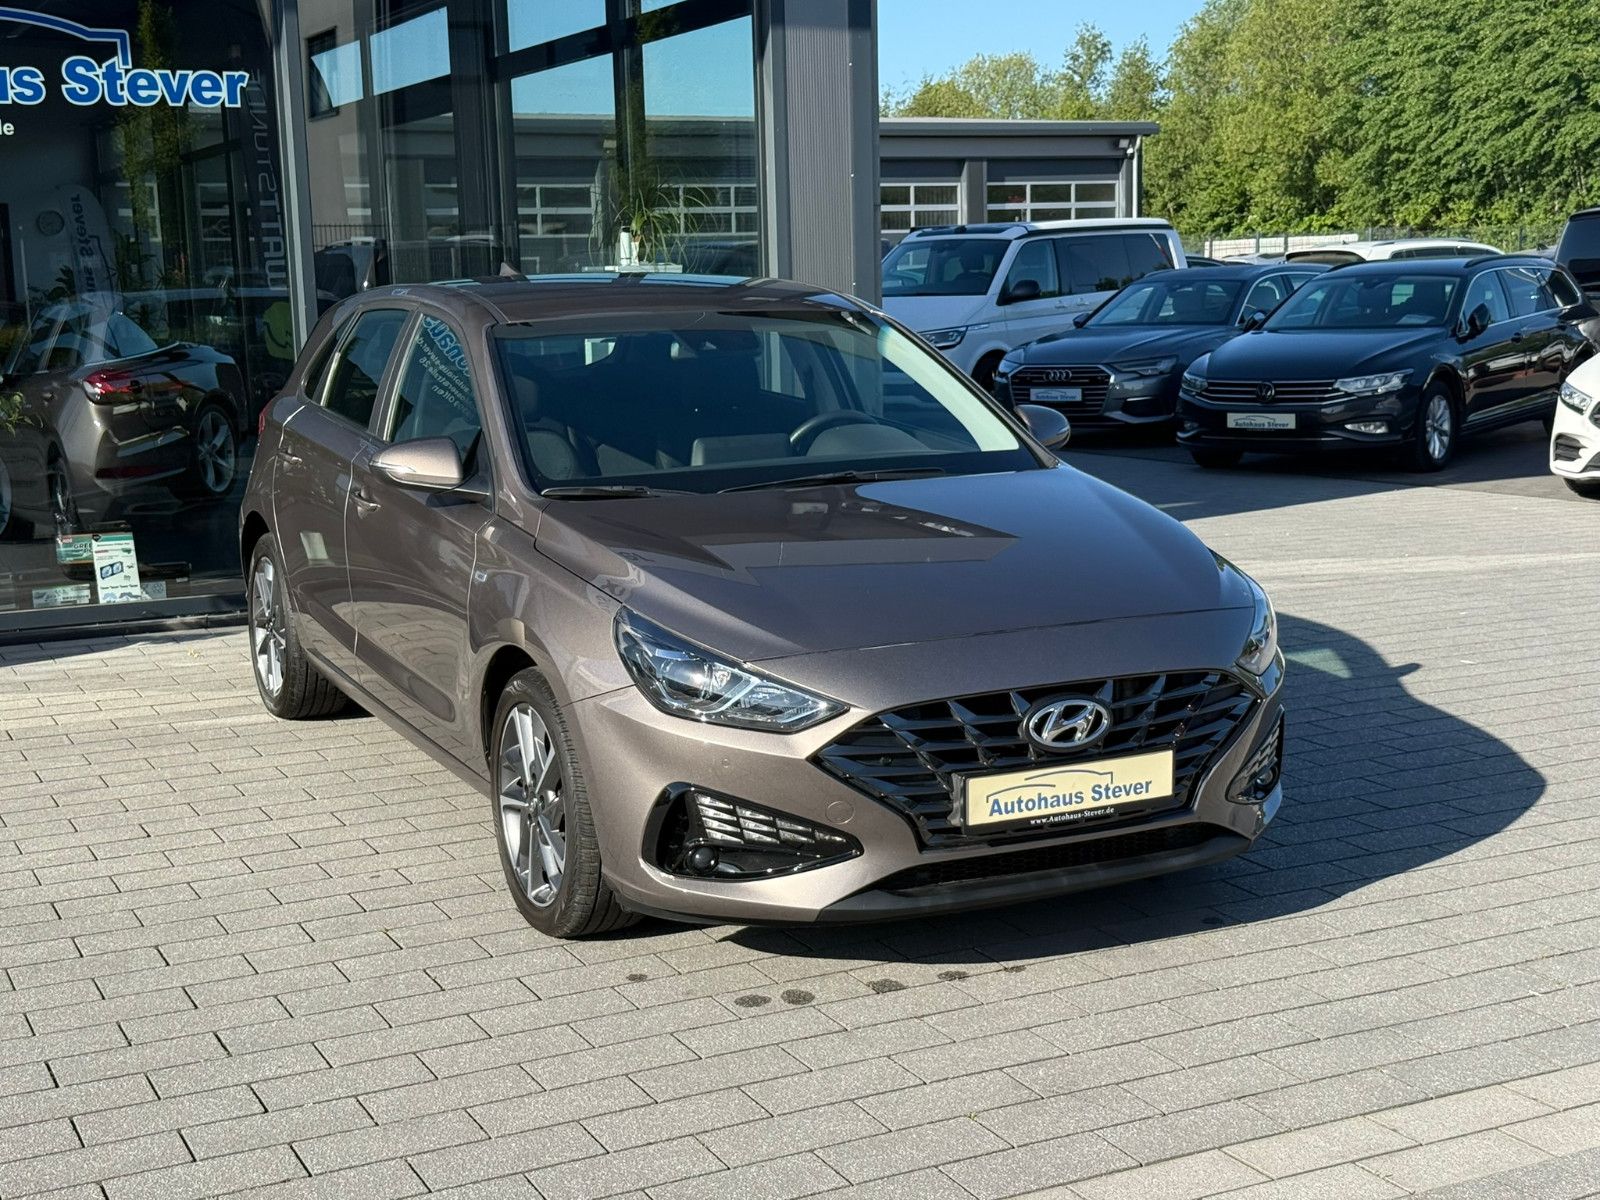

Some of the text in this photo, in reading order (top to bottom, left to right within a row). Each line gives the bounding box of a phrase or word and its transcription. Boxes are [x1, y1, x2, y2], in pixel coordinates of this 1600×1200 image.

[61, 55, 250, 107] Stever
[989, 779, 1153, 816] Autohaus Stever
[1030, 806, 1115, 825] www.Autohaus-Stever.de
